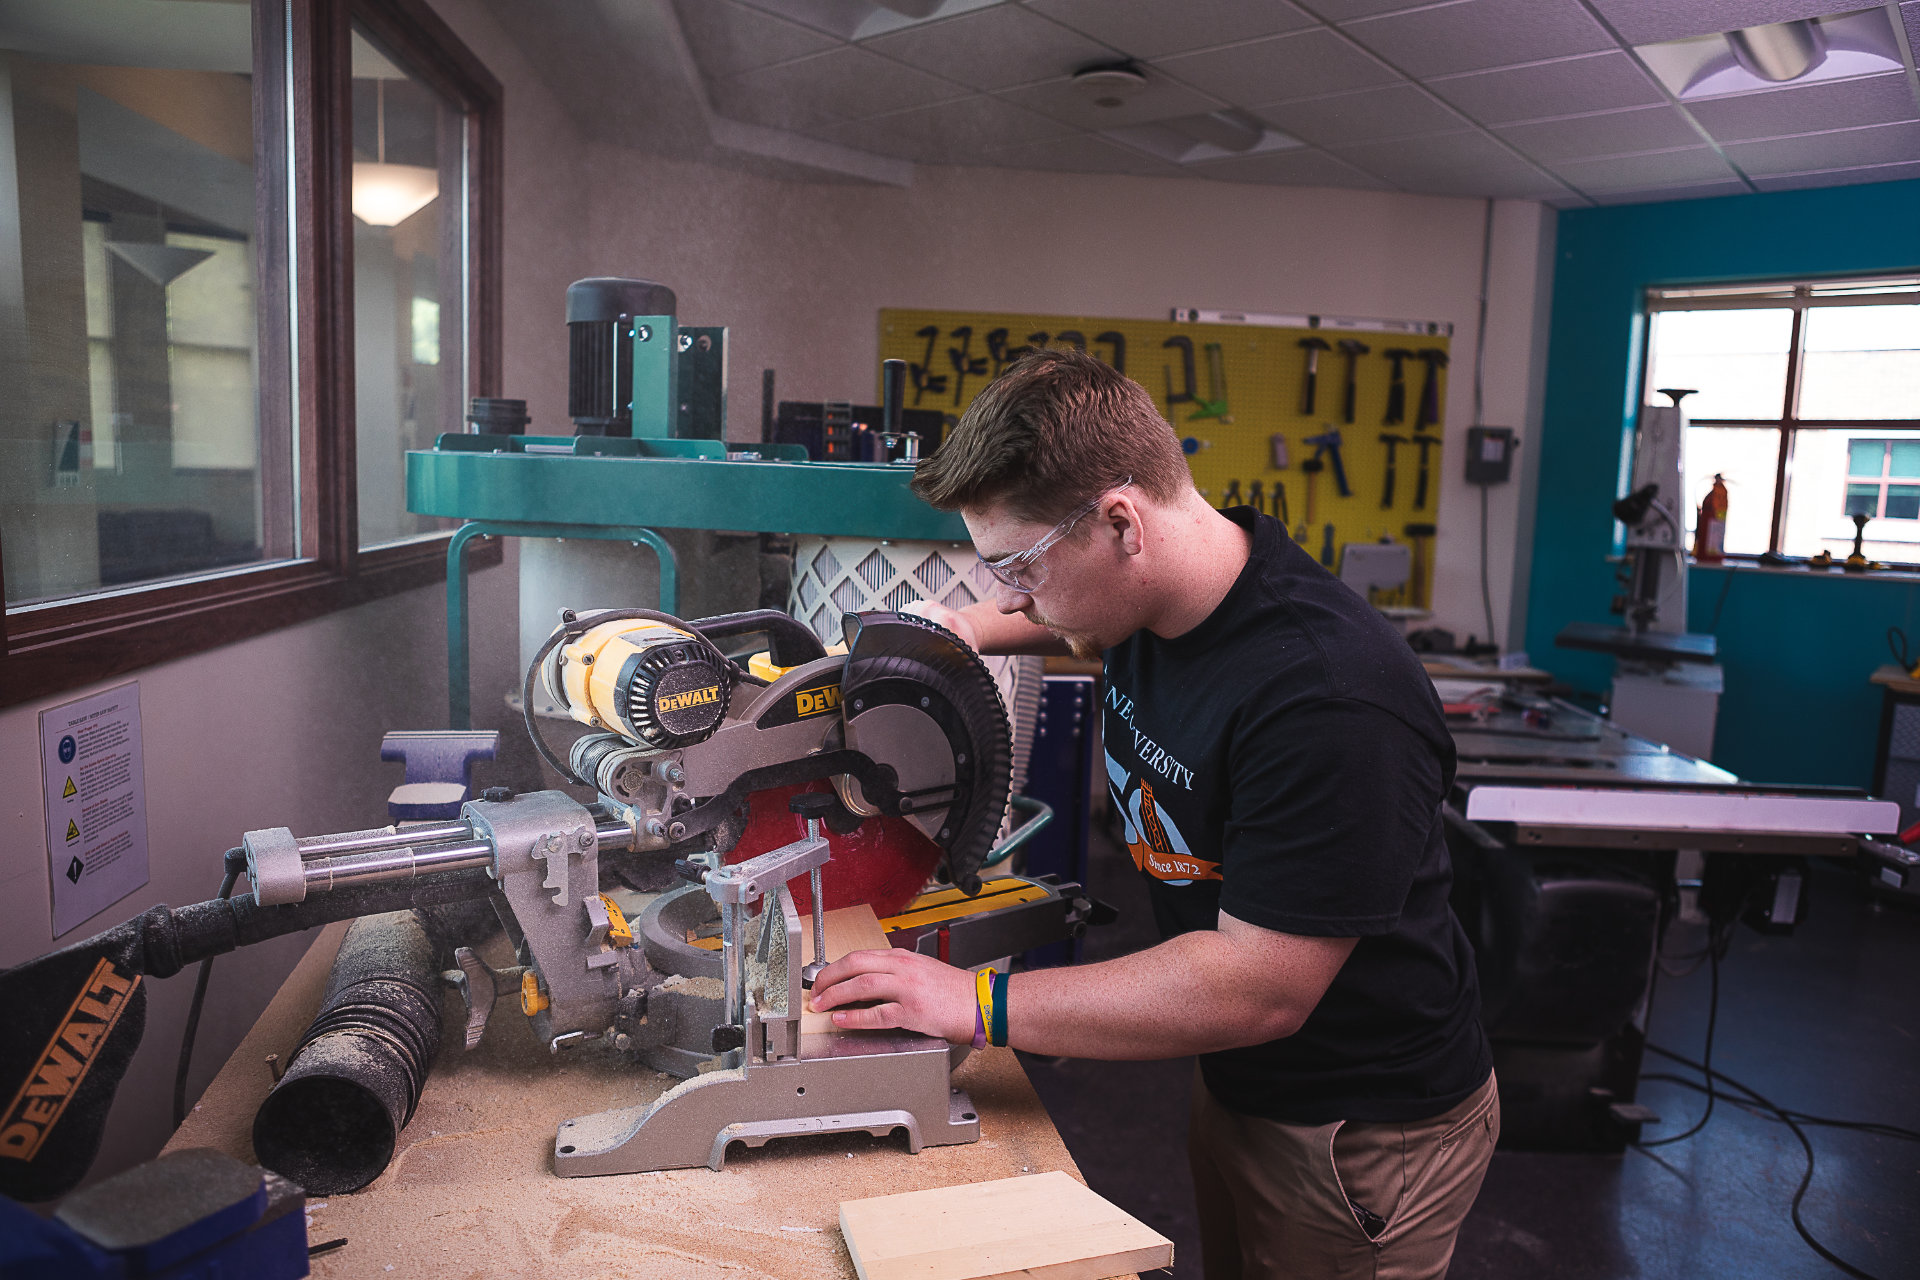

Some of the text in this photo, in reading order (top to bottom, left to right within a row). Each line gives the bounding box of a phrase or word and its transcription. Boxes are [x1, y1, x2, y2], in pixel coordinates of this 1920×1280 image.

[658, 687, 719, 712] DEWALT
[797, 686, 843, 715] DEW
[1131, 716, 1194, 790] VERSITY
[1149, 853, 1201, 875] Since 1872
[0, 960, 132, 1159] DEWALT
